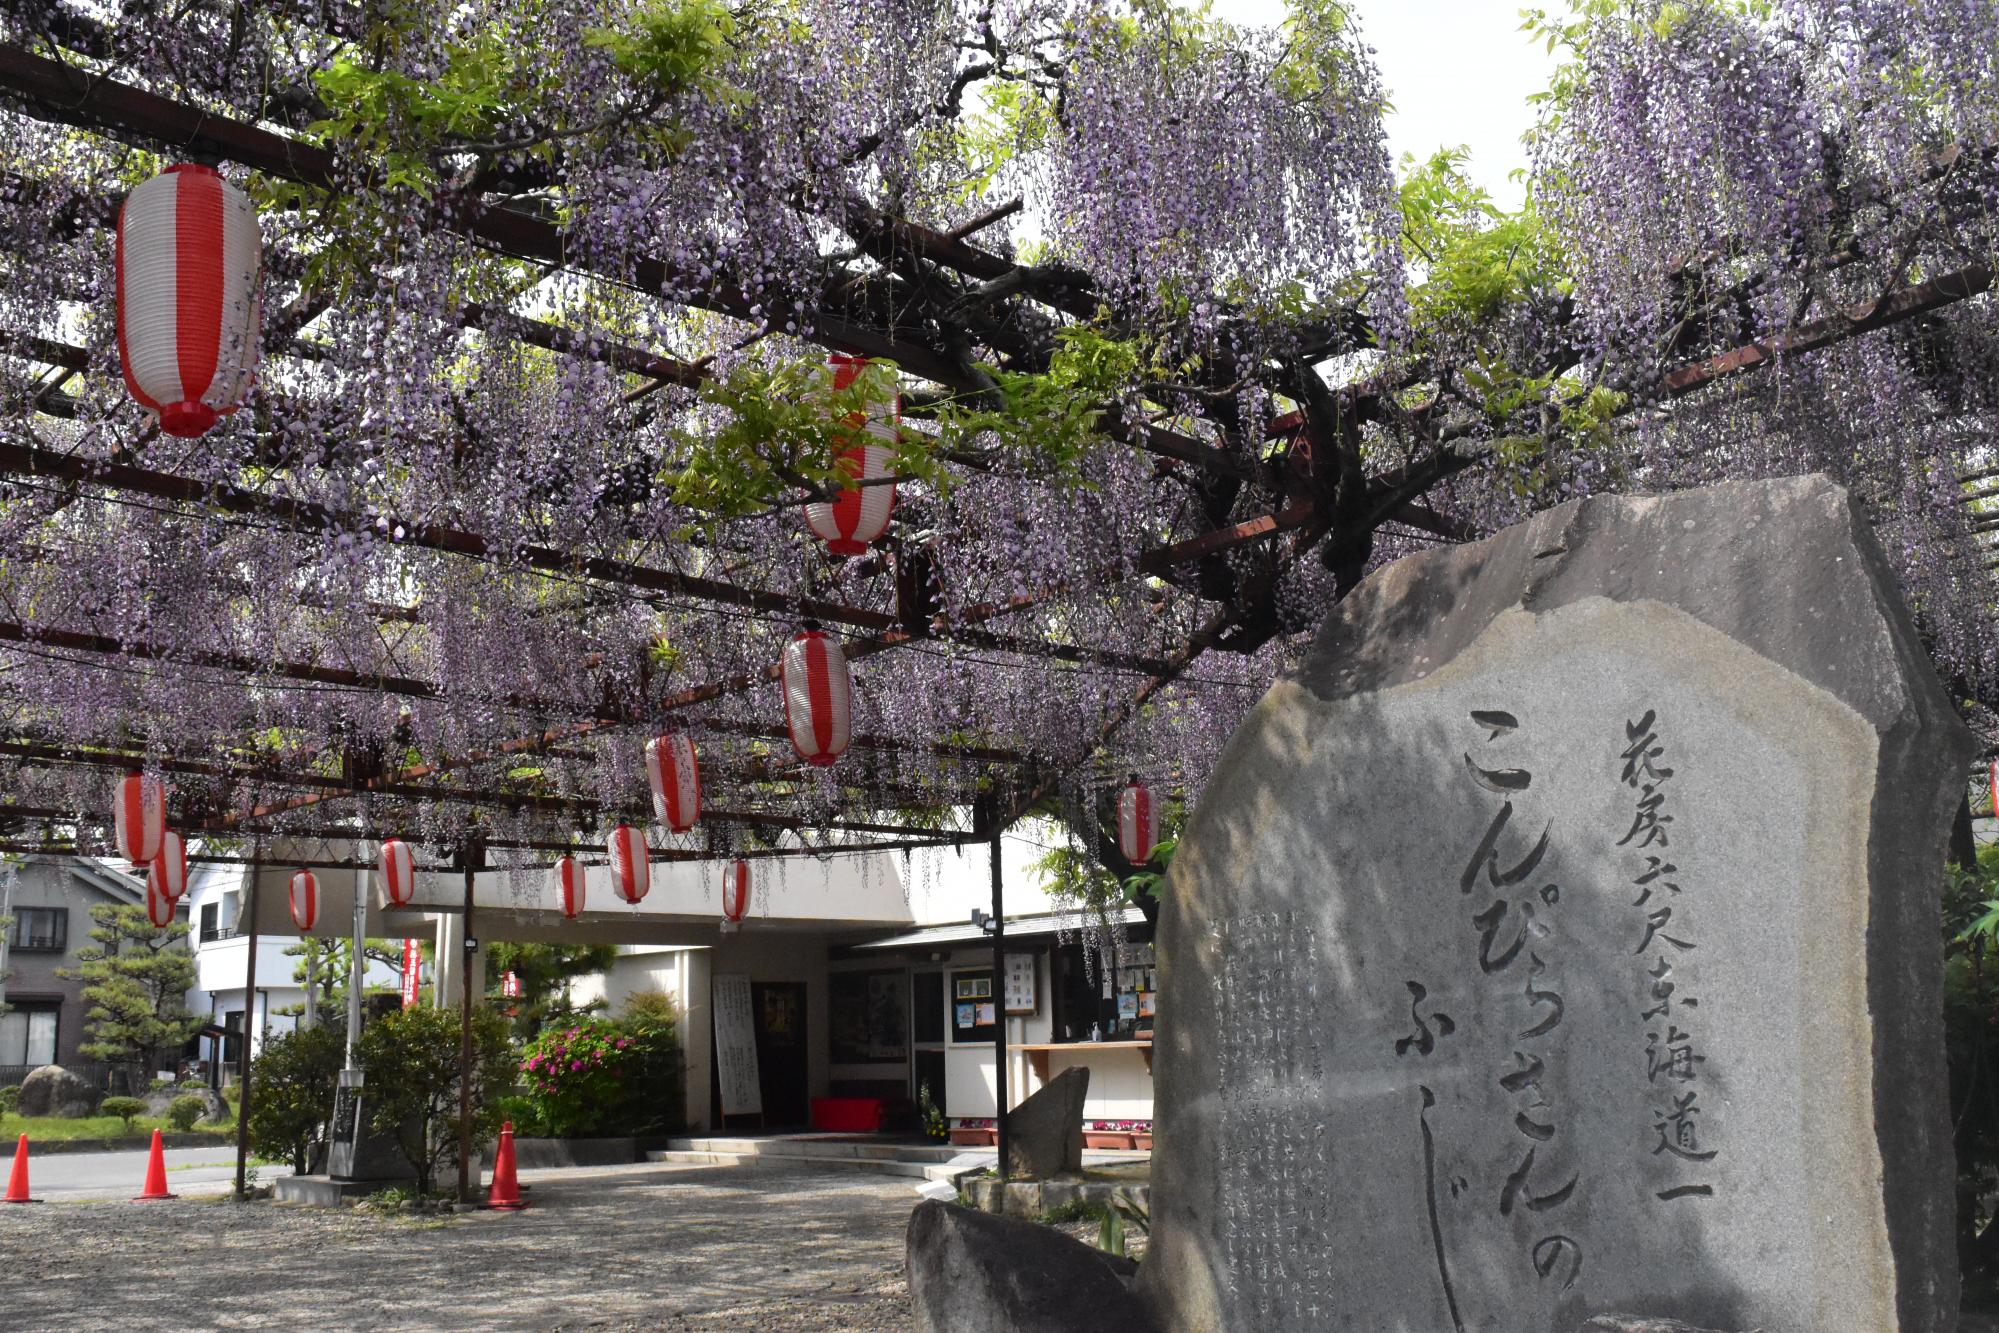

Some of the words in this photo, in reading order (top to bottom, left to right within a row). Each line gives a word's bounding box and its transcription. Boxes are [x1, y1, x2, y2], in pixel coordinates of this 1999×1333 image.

[1395, 979, 1468, 1333] ふじ
[1459, 709, 1584, 1291] こんぴらさんの
[1615, 709, 1719, 1201] 花房六尺東海道一
